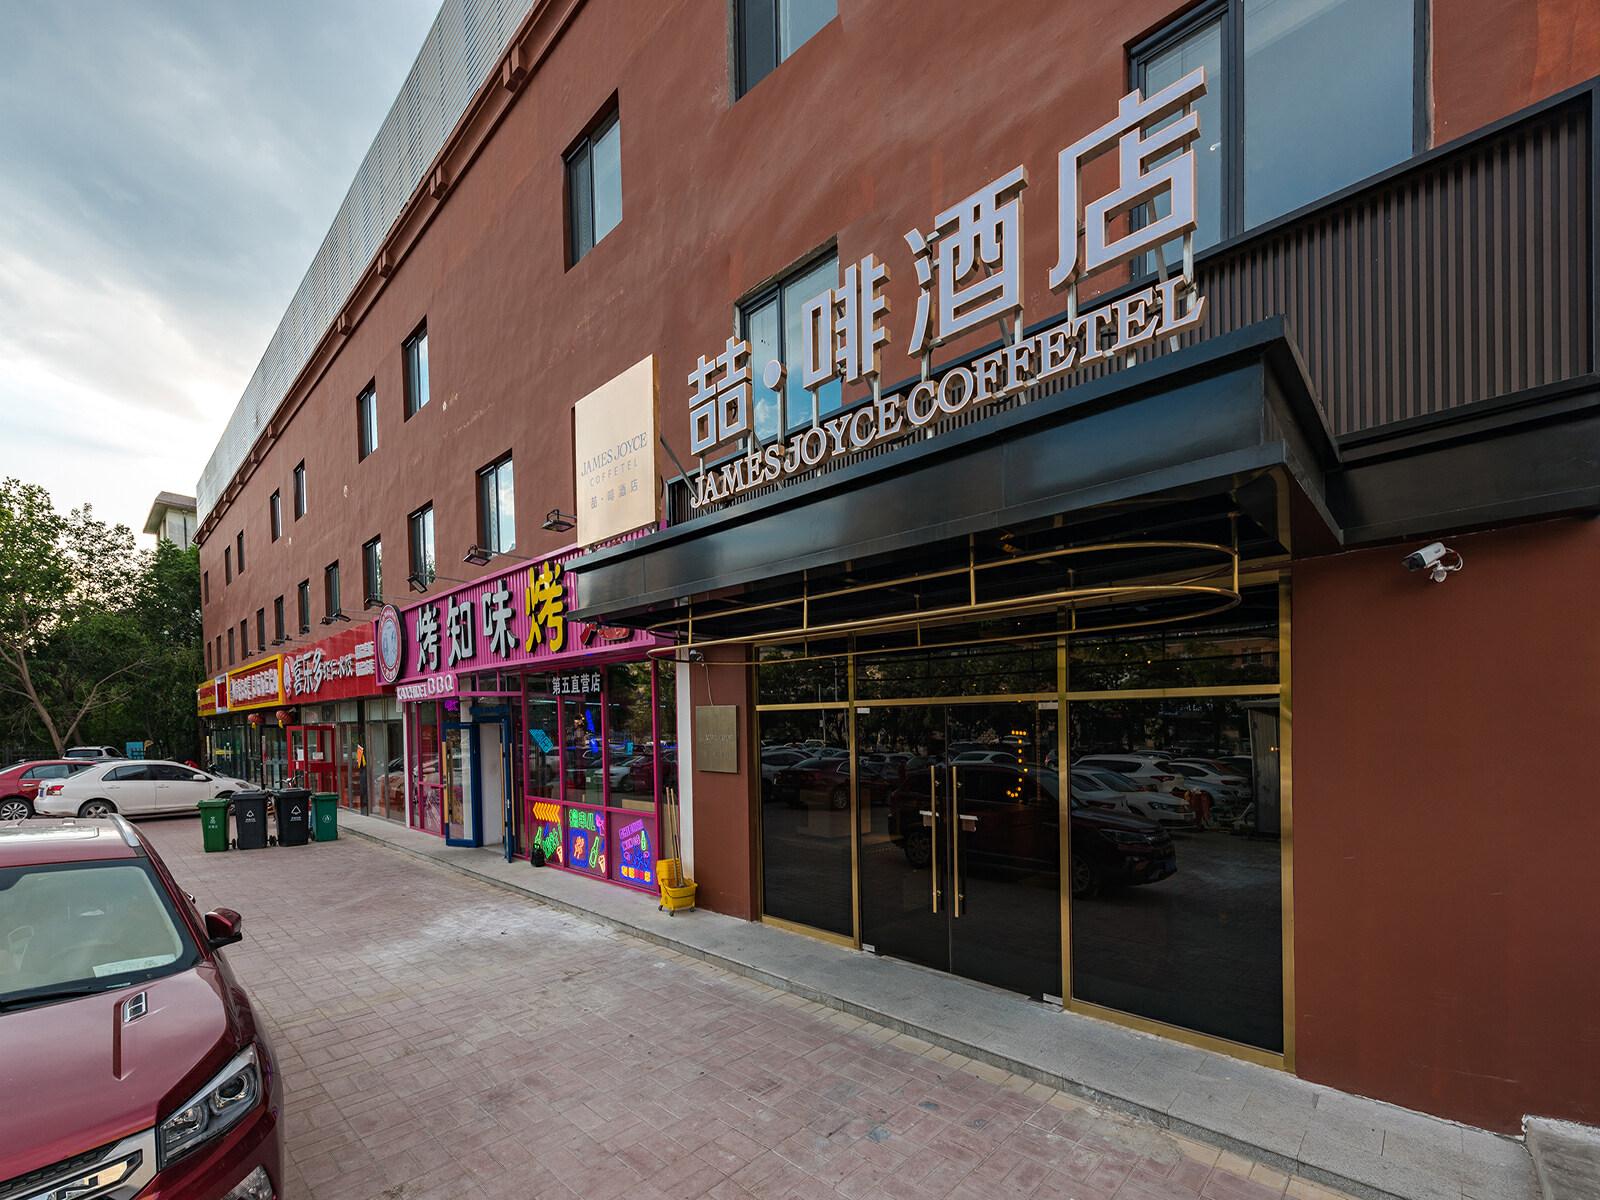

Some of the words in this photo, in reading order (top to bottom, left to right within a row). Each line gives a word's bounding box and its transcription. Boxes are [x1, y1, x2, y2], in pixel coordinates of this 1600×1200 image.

[690, 444, 782, 509] JAMES
[783, 392, 904, 474] JOYCE
[905, 274, 1205, 426] COFFETEL
[581, 448, 613, 477] JAMES
[613, 431, 648, 460] JOYCE
[551, 671, 601, 695] 第五直营店
